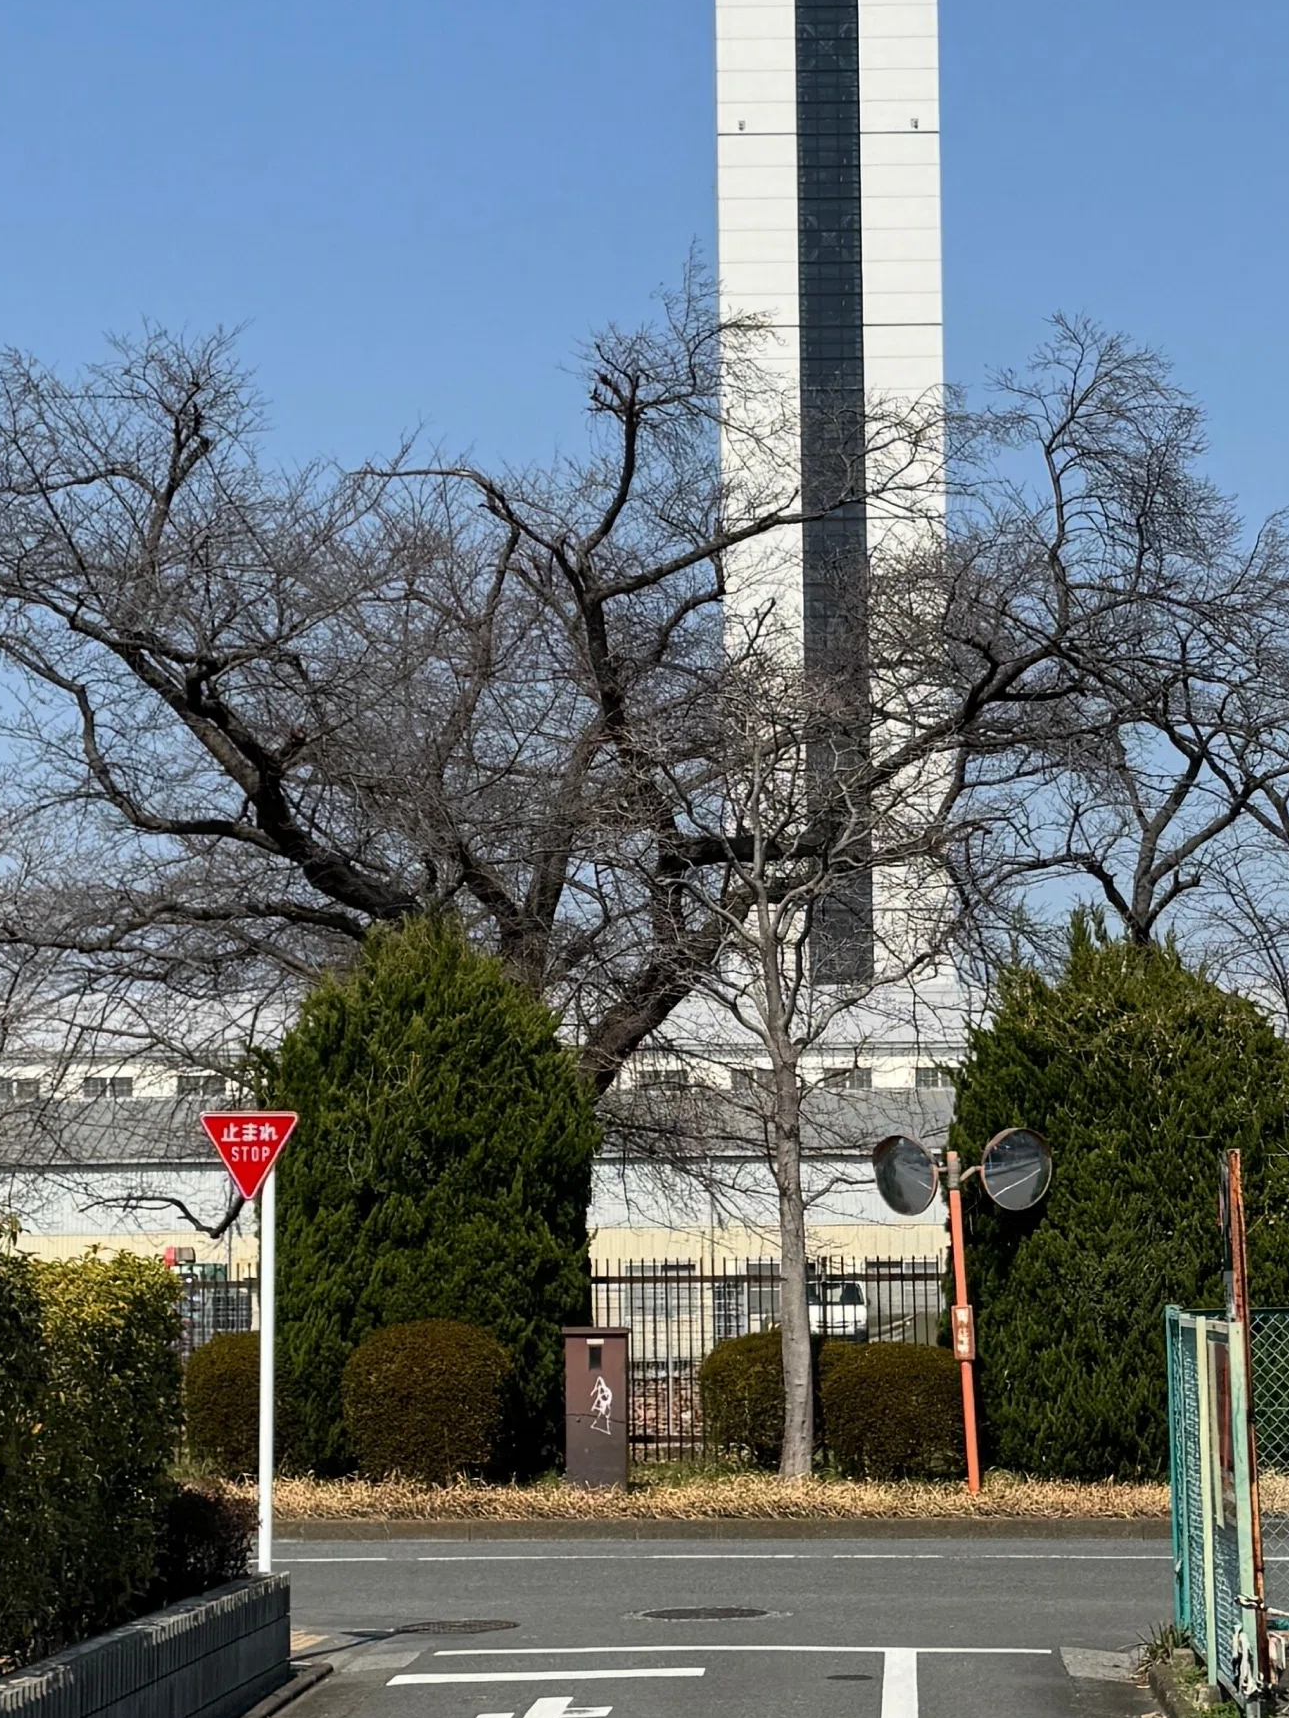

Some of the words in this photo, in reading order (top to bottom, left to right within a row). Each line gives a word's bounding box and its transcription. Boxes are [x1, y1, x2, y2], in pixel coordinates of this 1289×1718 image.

[220, 1122, 279, 1142] 止まれ
[231, 1146, 271, 1163] STOP
